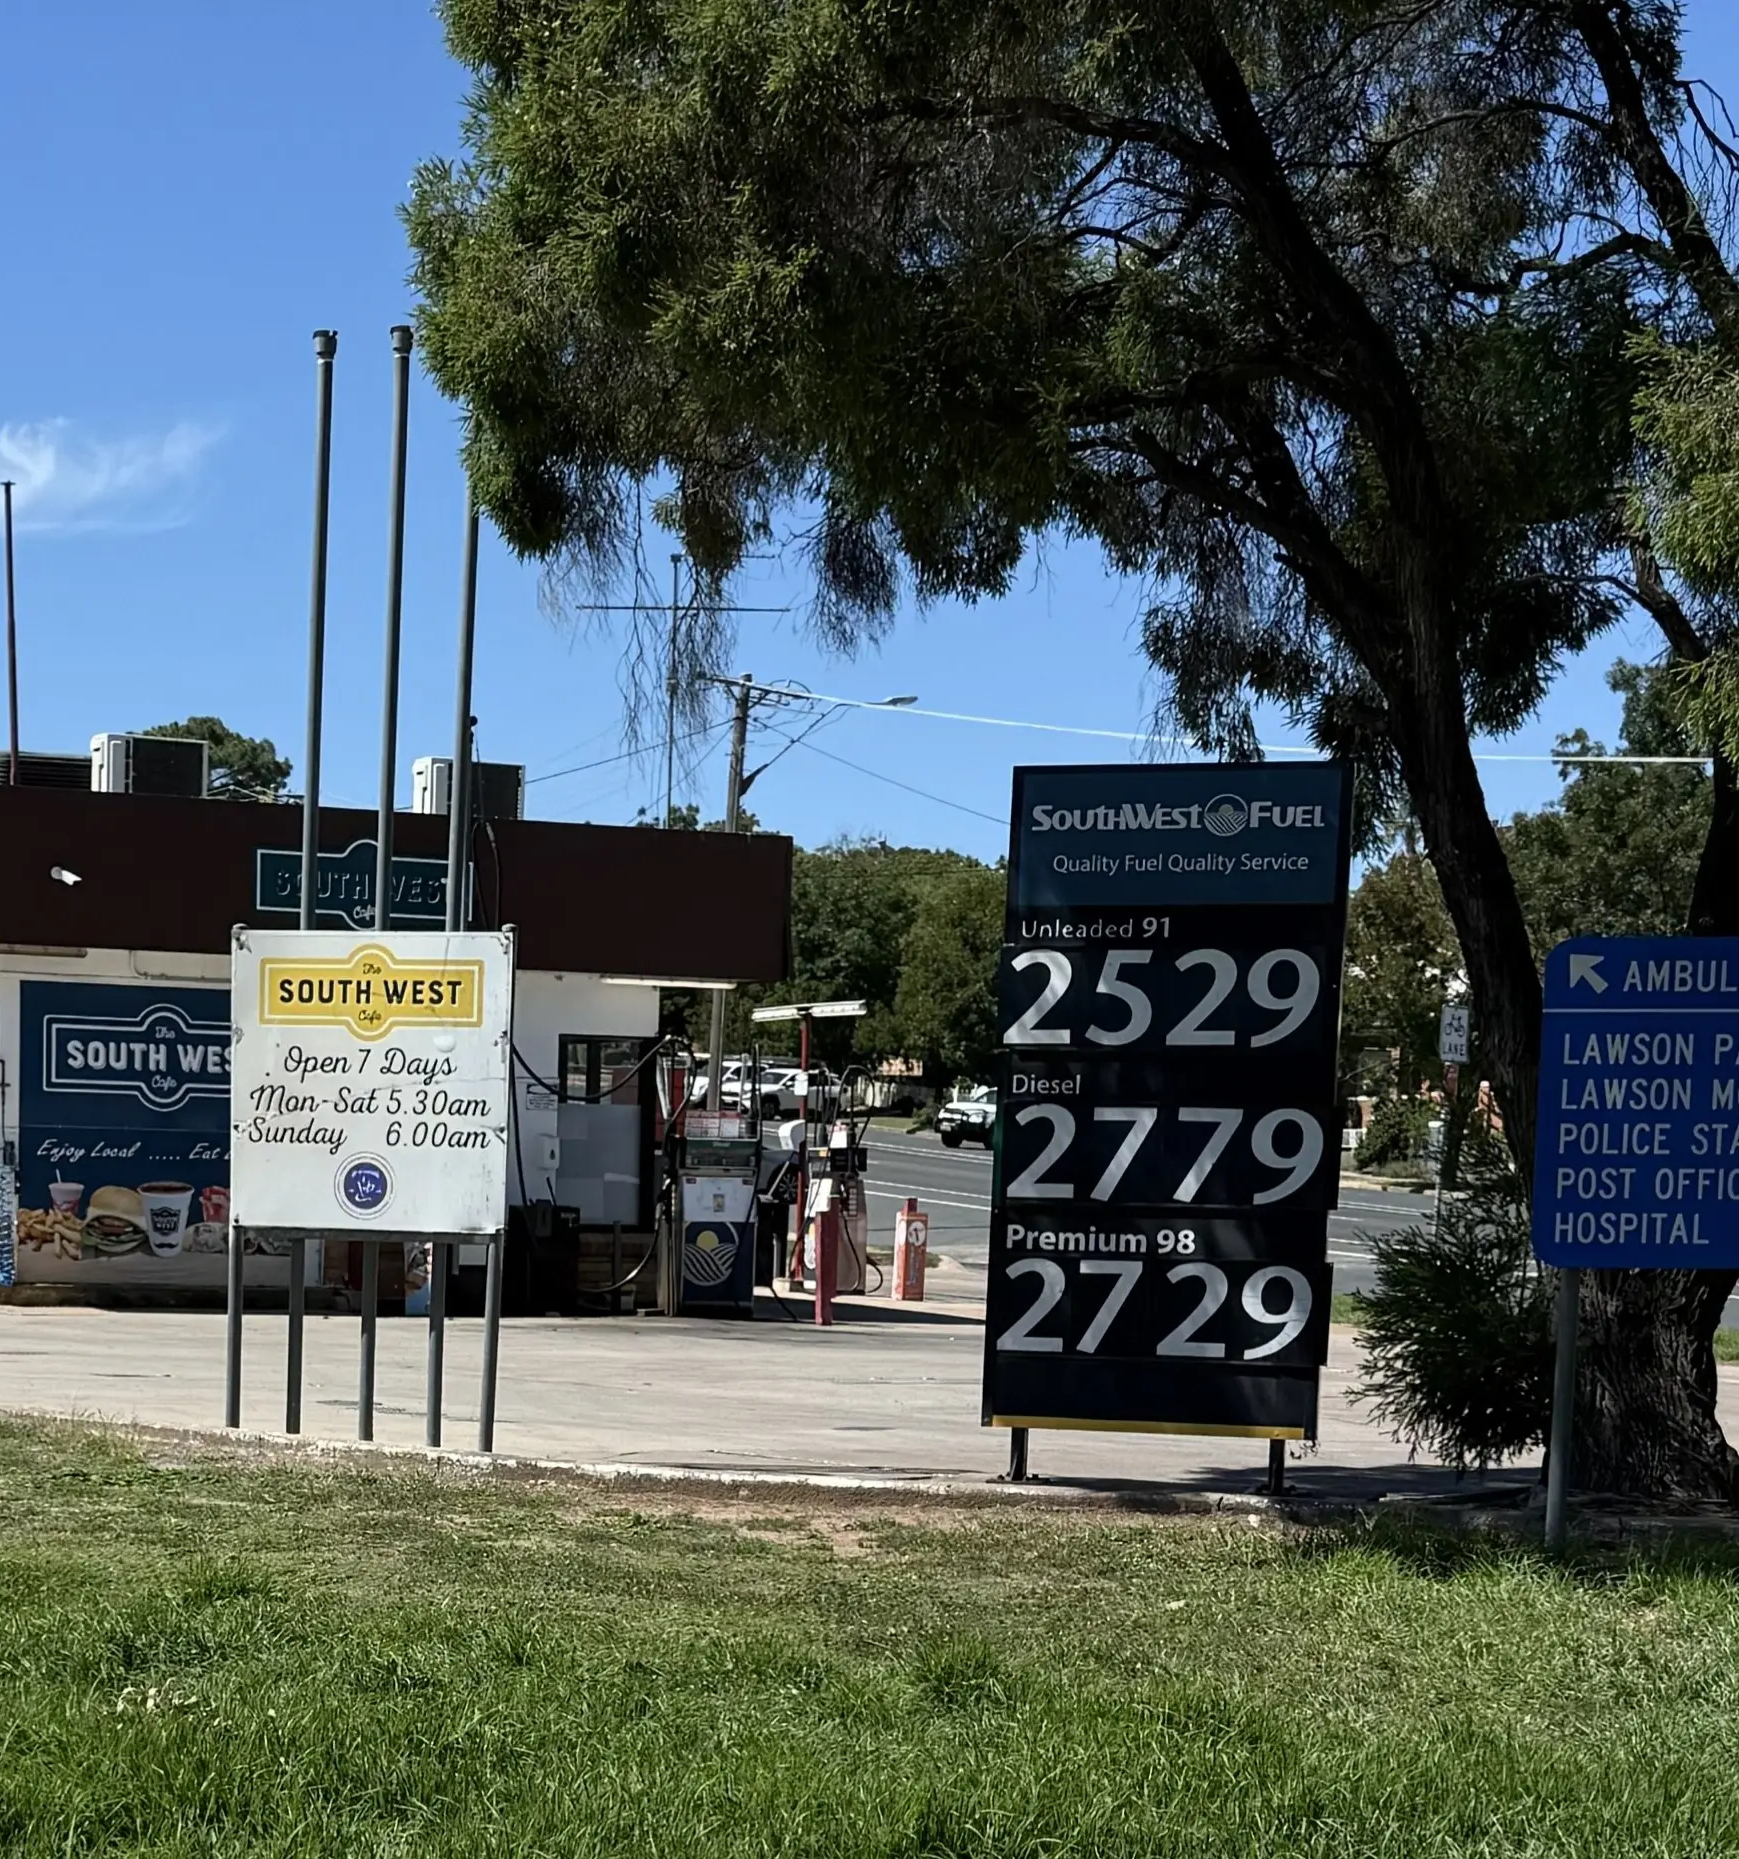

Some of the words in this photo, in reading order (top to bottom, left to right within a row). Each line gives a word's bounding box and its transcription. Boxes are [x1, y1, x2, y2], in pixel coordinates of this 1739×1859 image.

[1249, 801, 1325, 828] FUEL
[1053, 855, 1120, 877] Quality
[1124, 853, 1163, 872] Fuel
[1168, 853, 1236, 875] Quality
[1240, 852, 1309, 872] Service
[1022, 917, 1133, 938] Unleaded
[1141, 916, 1171, 938] 91
[363, 963, 382, 975] The
[279, 979, 371, 1004] SOUTH
[384, 980, 462, 1005] WEST
[1003, 948, 1320, 1048] 2529
[66, 1039, 167, 1072] SOUTH
[1443, 1043, 1466, 1057] LANE
[1563, 1033, 1694, 1065] LAWSON
[284, 1046, 352, 1083] Open
[358, 1049, 372, 1074] 7
[379, 1047, 457, 1085] Days
[250, 1084, 379, 1115] Mon-Sat
[386, 1089, 492, 1117] 5.30am
[1012, 1074, 1081, 1095] Diesel
[1561, 1078, 1691, 1110] LAWSON
[36, 1138, 87, 1163] Enjoy
[90, 1141, 142, 1158] Local
[188, 1141, 222, 1160] Eat
[249, 1116, 348, 1155] Sunday
[386, 1120, 492, 1149] 6.00am
[1558, 1122, 1671, 1155] POLICE
[1007, 1103, 1324, 1205] 2779
[1557, 1167, 1636, 1199] POST
[1006, 1224, 1147, 1253] Premium
[1157, 1229, 1196, 1255] 98
[1554, 1212, 1709, 1244] HOSPITAL
[996, 1258, 1313, 1361] 2729
